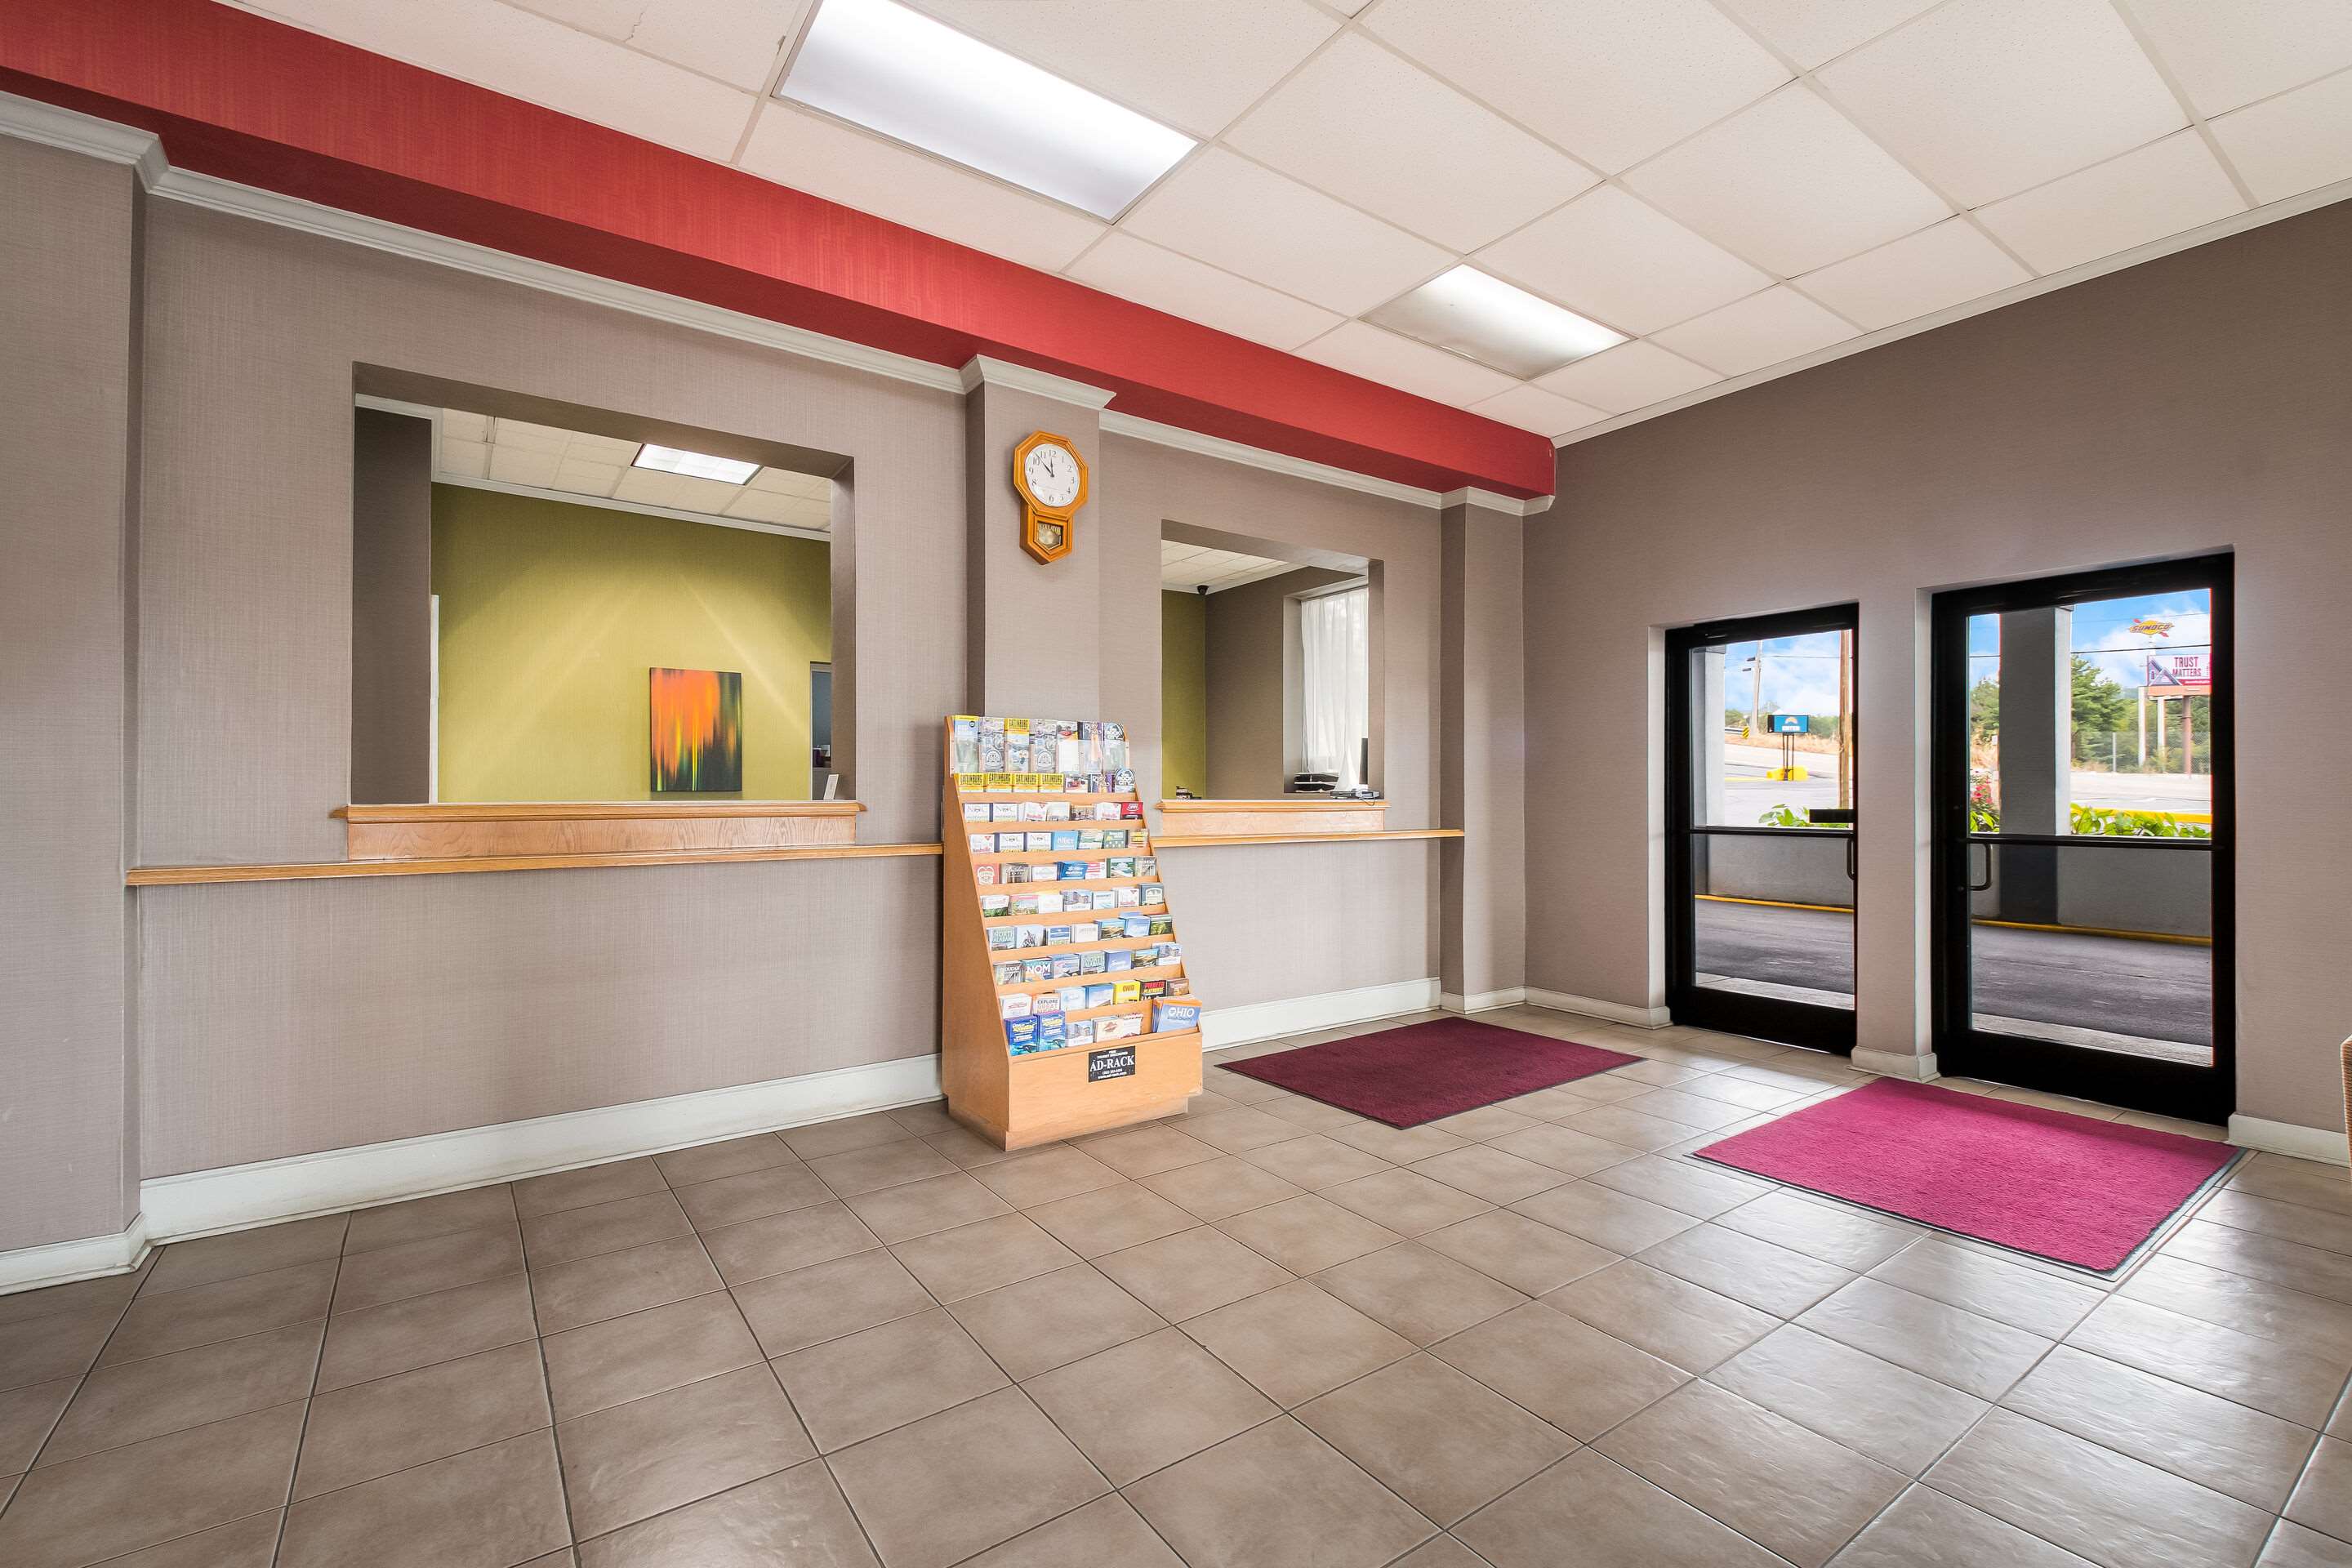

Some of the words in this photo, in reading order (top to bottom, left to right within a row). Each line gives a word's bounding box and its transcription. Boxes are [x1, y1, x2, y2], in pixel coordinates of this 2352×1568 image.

[1040, 450, 1046, 459] 11
[1049, 449, 1057, 458] 12
[1032, 457, 1040, 466] 10
[1028, 466, 1034, 475] 9
[1067, 465, 1072, 473] 2
[1031, 478, 1037, 487] 8
[1066, 487, 1071, 495] 4
[1049, 494, 1054, 502] 6
[2131, 623, 2170, 631] SUNOCO
[2174, 657, 2198, 667] TRUST
[2172, 668, 2202, 677] MATTERS
[1168, 1007, 1195, 1018] OHIO
[1089, 1054, 1135, 1072] AD-RACK
